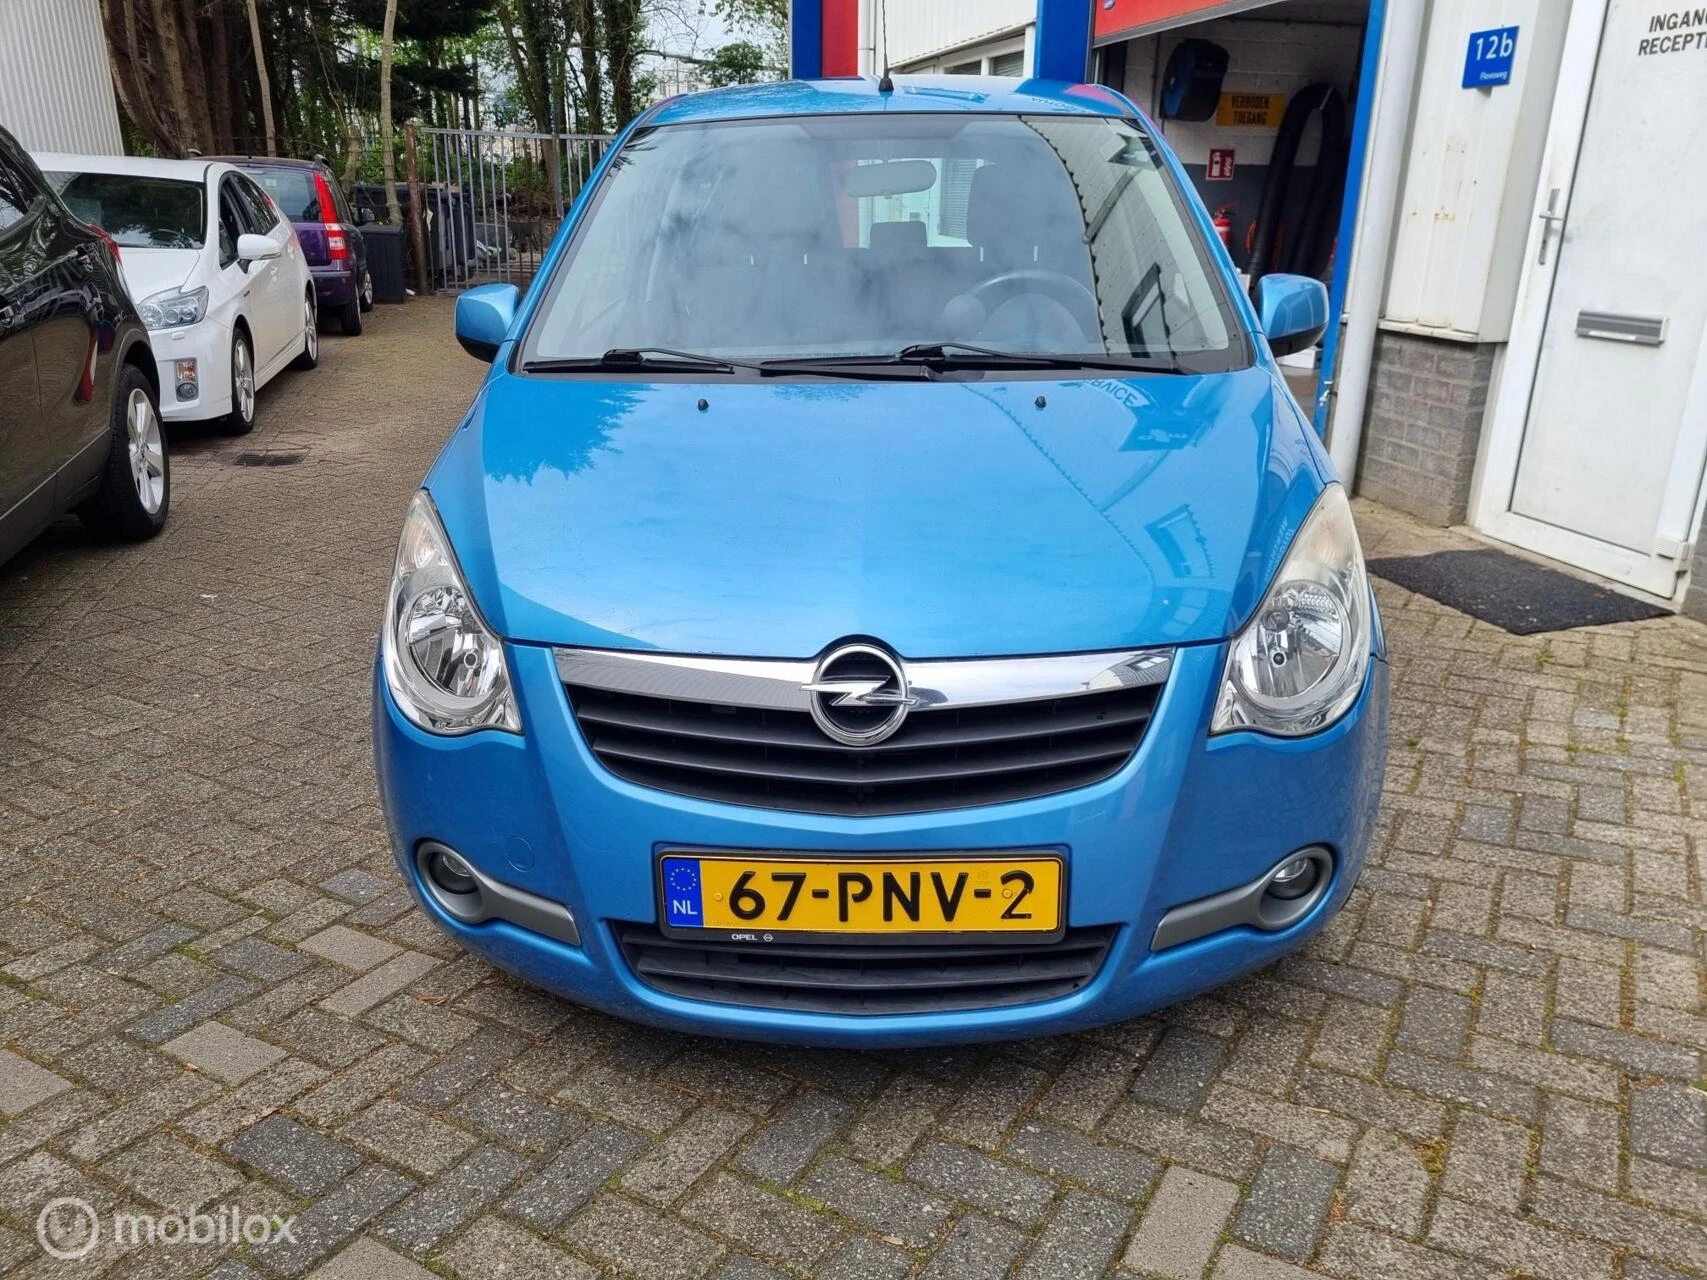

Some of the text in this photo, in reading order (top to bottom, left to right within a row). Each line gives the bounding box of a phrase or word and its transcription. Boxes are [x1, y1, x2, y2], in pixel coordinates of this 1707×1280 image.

[1648, 7, 1707, 33] INGAN
[1476, 32, 1513, 61] 12b
[1232, 95, 1270, 109] VERBODEN
[1233, 110, 1268, 125] TOEGANG
[728, 870, 1034, 922] 67-PNV-2
[673, 899, 698, 915] NL
[731, 933, 758, 941] OPEL
